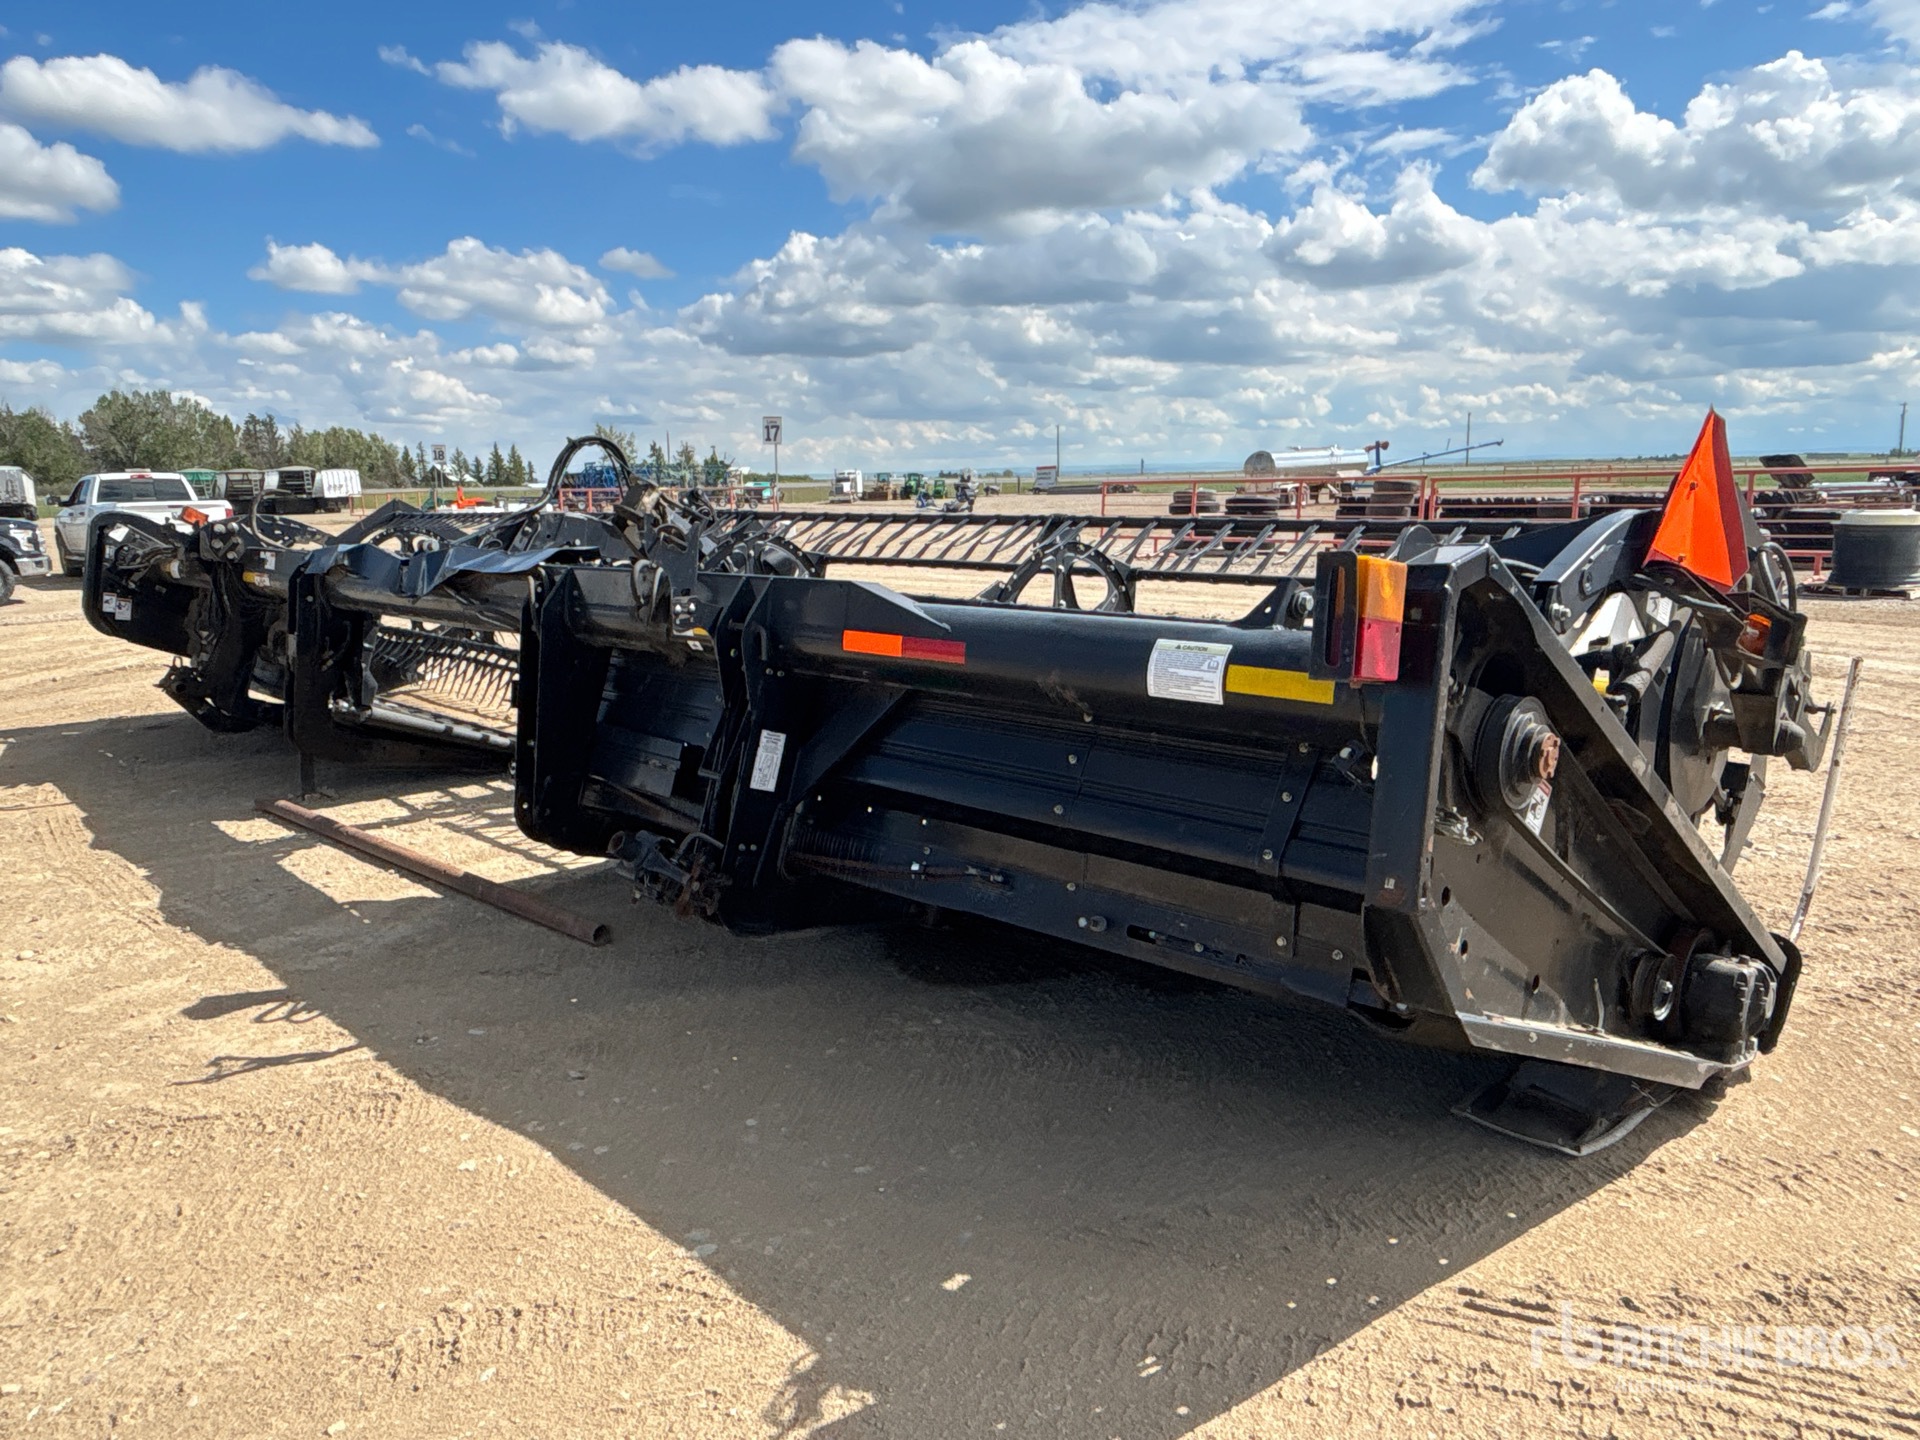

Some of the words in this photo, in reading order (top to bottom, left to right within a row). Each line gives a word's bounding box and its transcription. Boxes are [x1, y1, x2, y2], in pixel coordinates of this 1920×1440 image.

[764, 425, 780, 441] 17
[432, 450, 445, 461] 18
[1182, 644, 1208, 652] CAUTION
